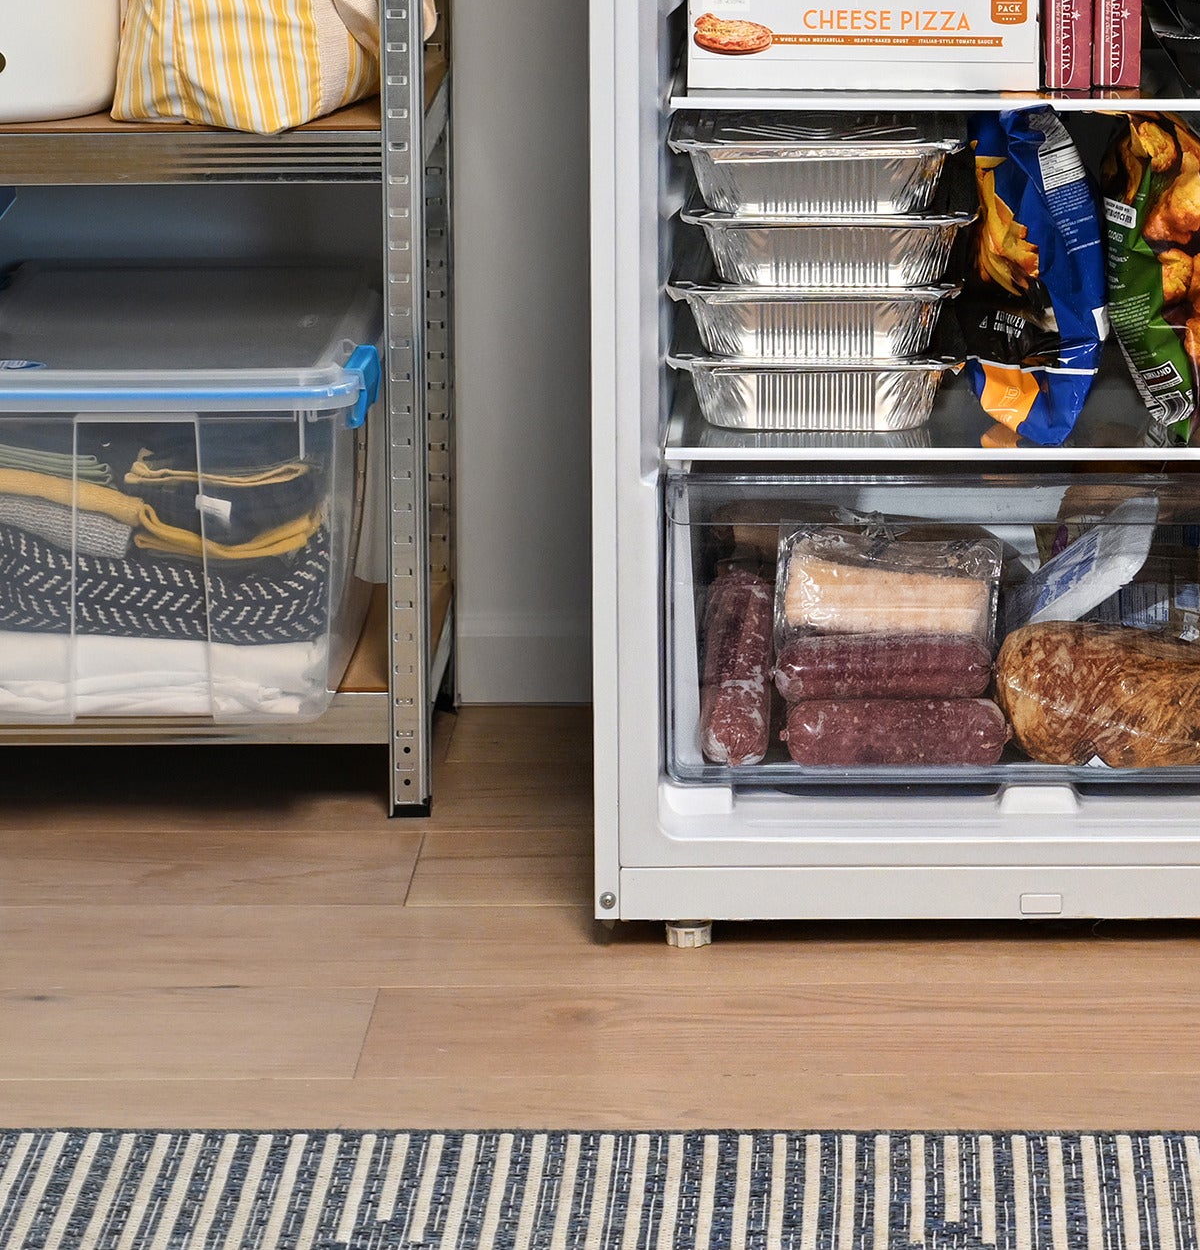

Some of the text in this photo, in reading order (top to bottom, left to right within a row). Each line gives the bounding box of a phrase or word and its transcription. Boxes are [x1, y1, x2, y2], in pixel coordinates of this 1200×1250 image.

[803, 8, 971, 31] CHEESE PIZZA
[997, 4, 1021, 13] PACK
[1061, 43, 1071, 71] STIX
[1110, 42, 1121, 69] STIX
